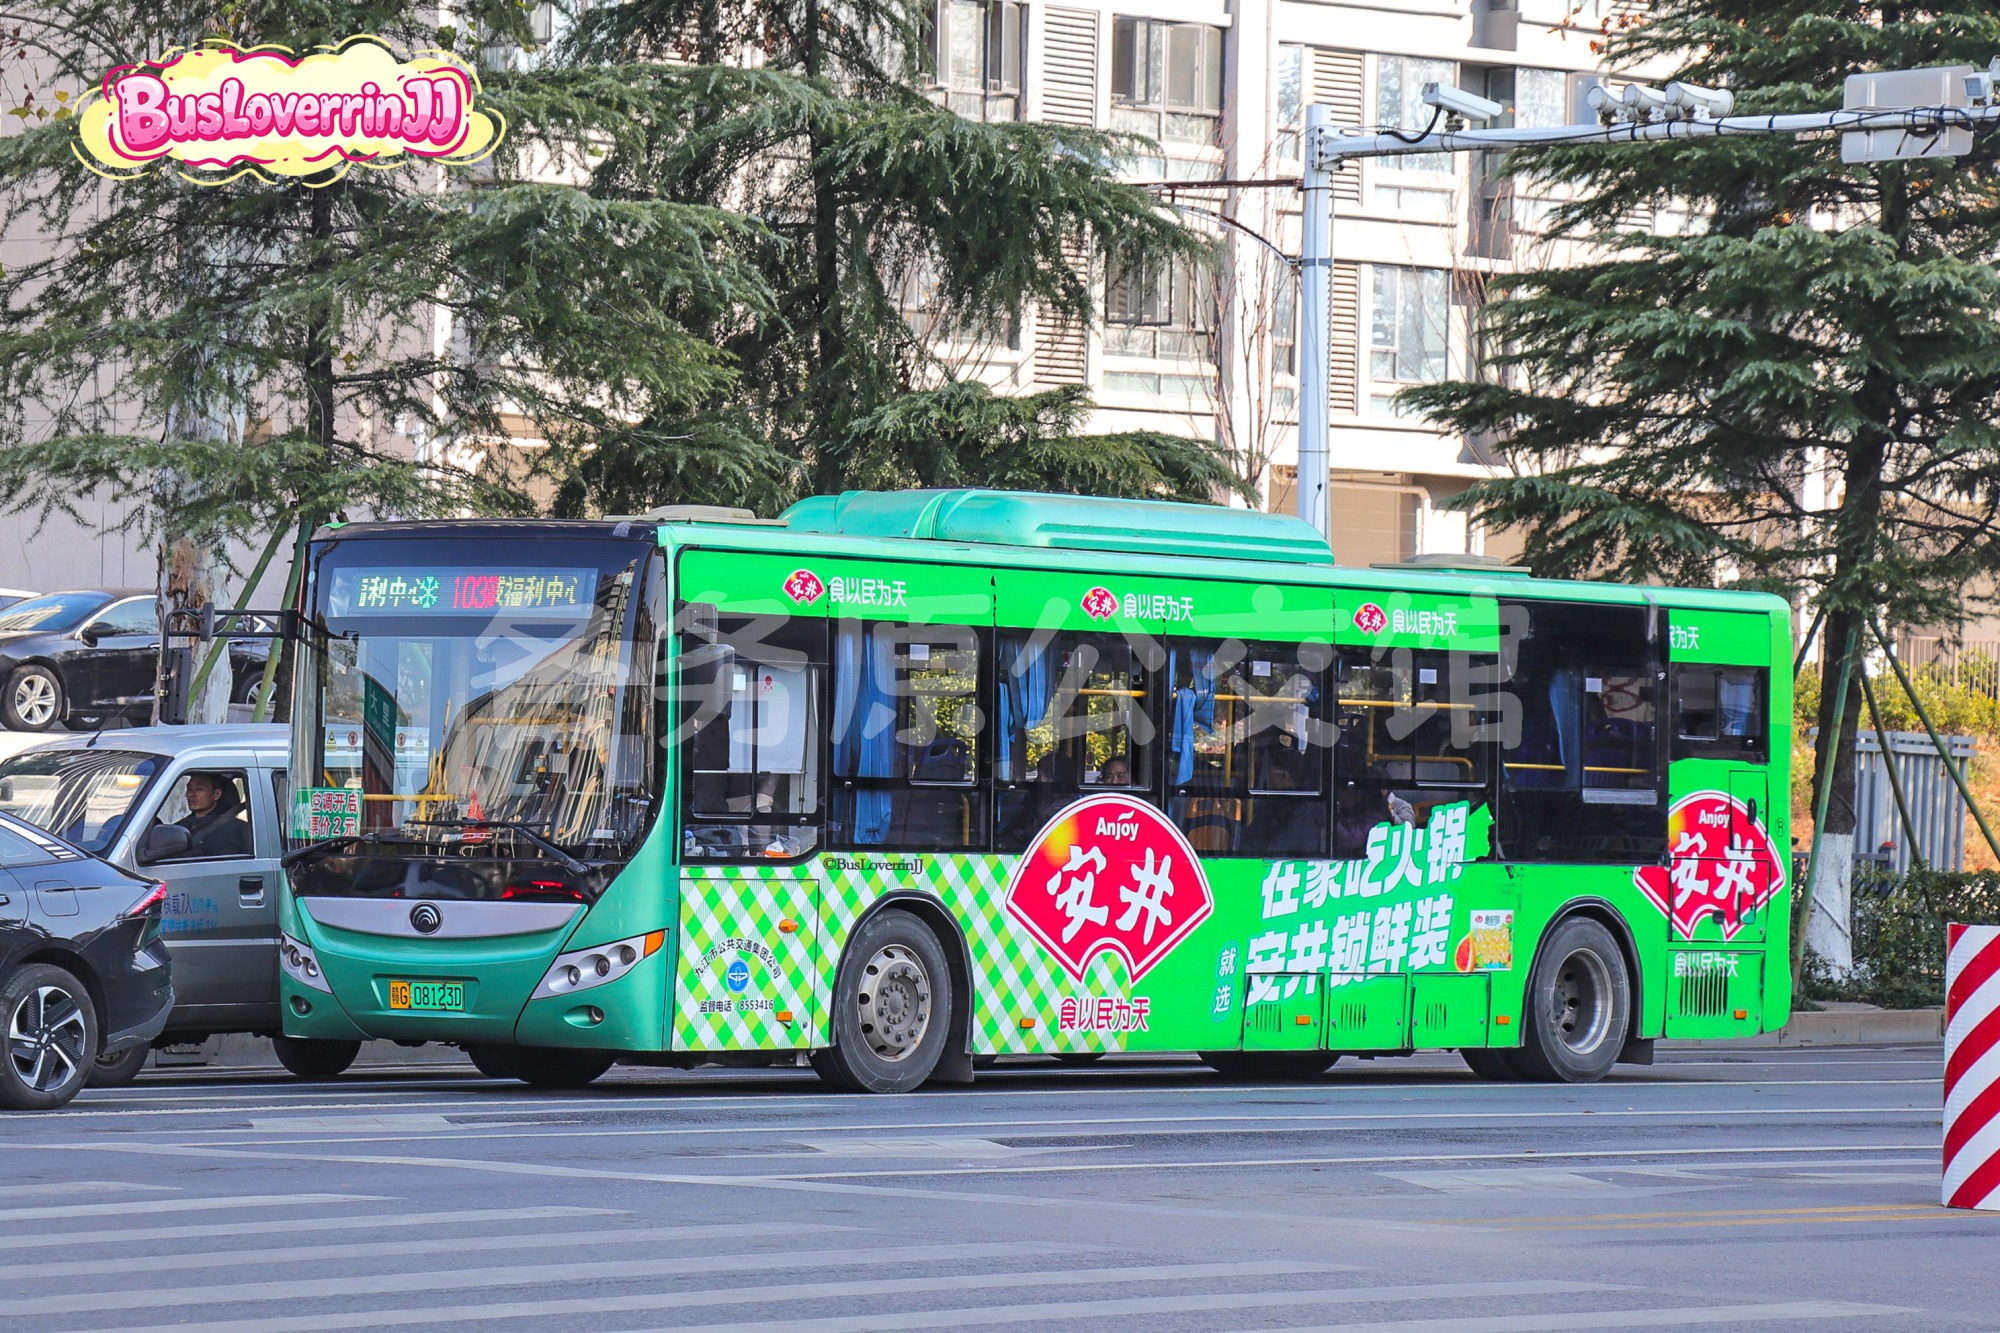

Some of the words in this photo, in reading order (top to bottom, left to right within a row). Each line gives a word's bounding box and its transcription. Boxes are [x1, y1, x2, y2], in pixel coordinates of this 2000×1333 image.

[828, 576, 907, 607] 食以民为天
[1123, 593, 1194, 622] 食以民为天
[1392, 608, 1457, 636] 食以民为天
[312, 792, 358, 814] 空调开启
[1698, 804, 1731, 829] Anjoy
[309, 816, 356, 838] 票价2元
[1095, 811, 1139, 842] Anjoy
[1261, 806, 1467, 920] 在家吃火锅
[1669, 832, 1757, 911] 安井
[1045, 844, 1175, 946] 安井
[694, 938, 782, 979] 九江市公共交通集团公司
[1242, 894, 1454, 1007] 安井锁鲜装
[1213, 946, 1237, 1015] 就选
[1058, 997, 1150, 1032] 食以民为天
